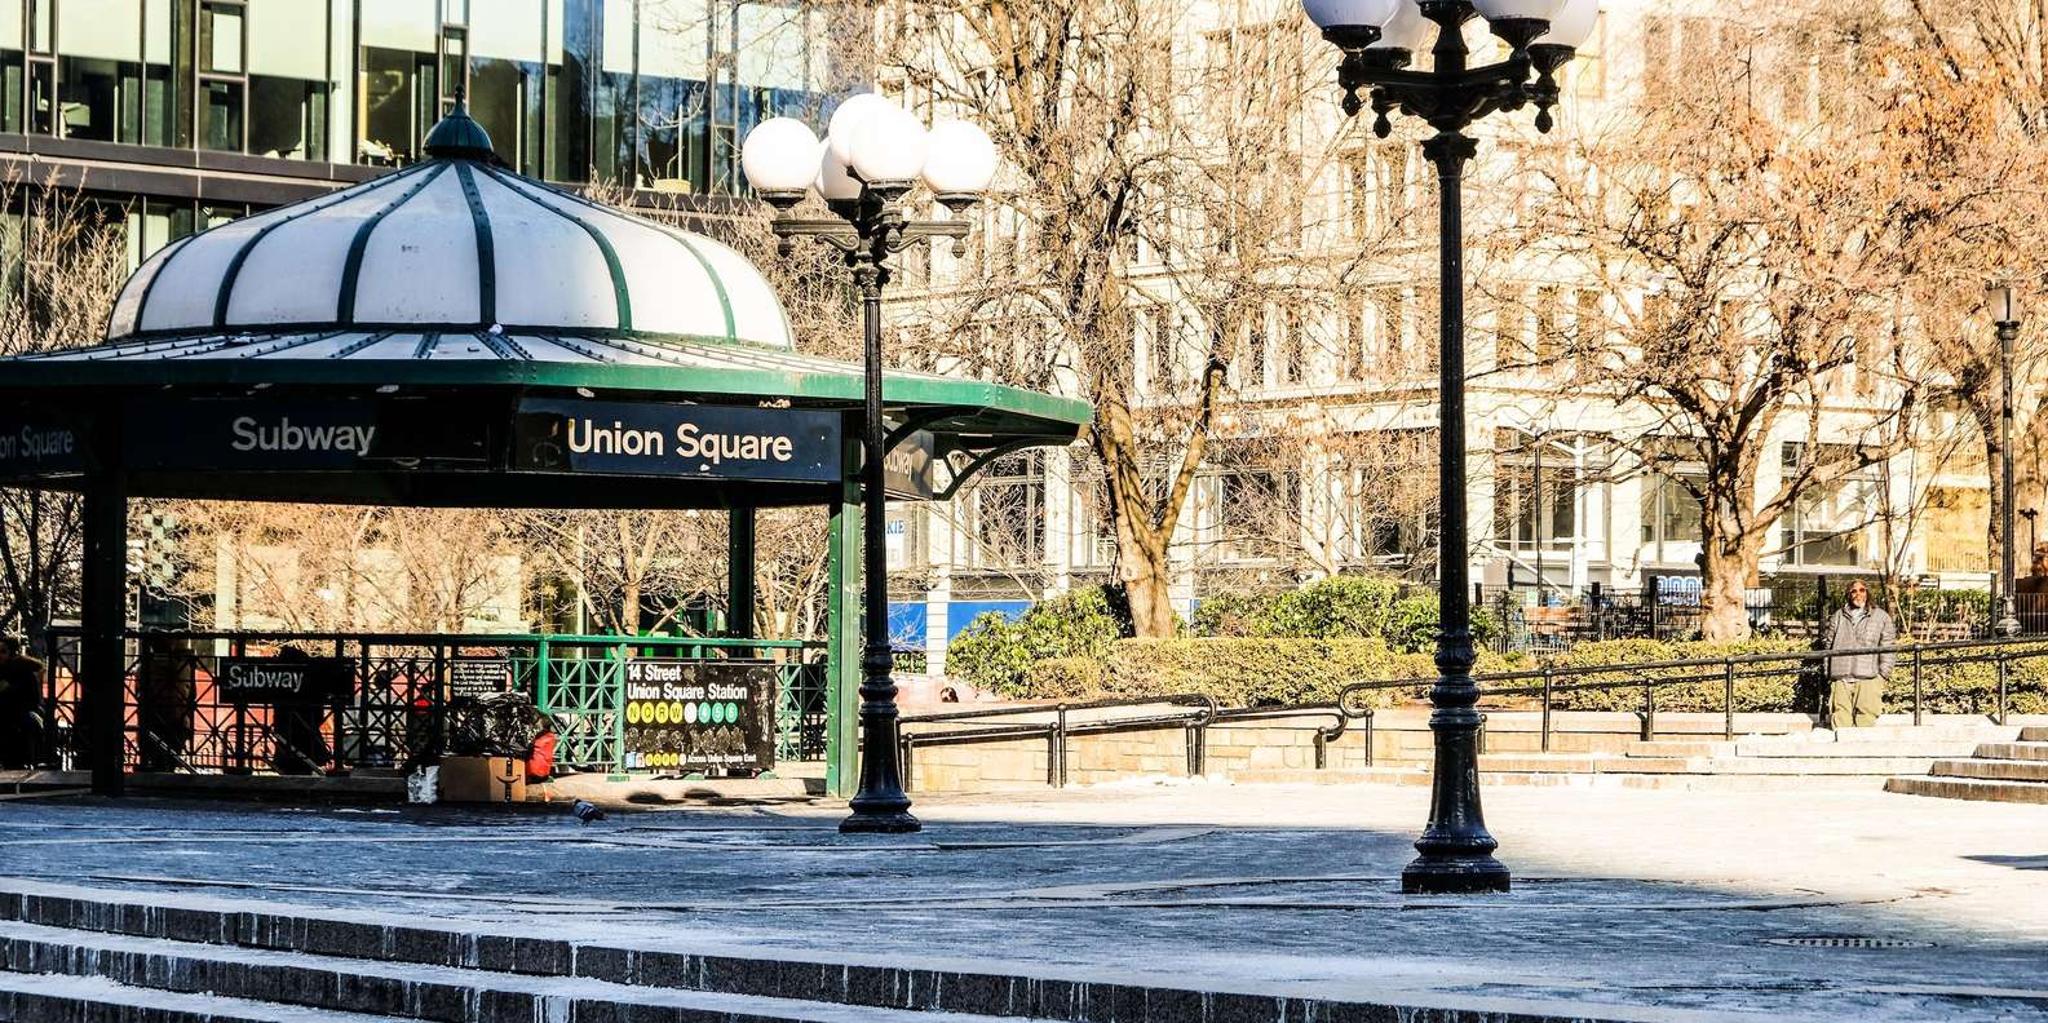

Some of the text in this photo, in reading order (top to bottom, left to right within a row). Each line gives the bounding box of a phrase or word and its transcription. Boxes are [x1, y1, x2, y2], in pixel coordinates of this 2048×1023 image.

[20, 424, 74, 462] Square
[231, 416, 376, 457] Subway
[567, 417, 793, 464] Union Square
[228, 665, 304, 693] Subway
[627, 664, 682, 681] 14 Street
[627, 682, 748, 701] Union Square Station
[724, 754, 743, 764] Square
